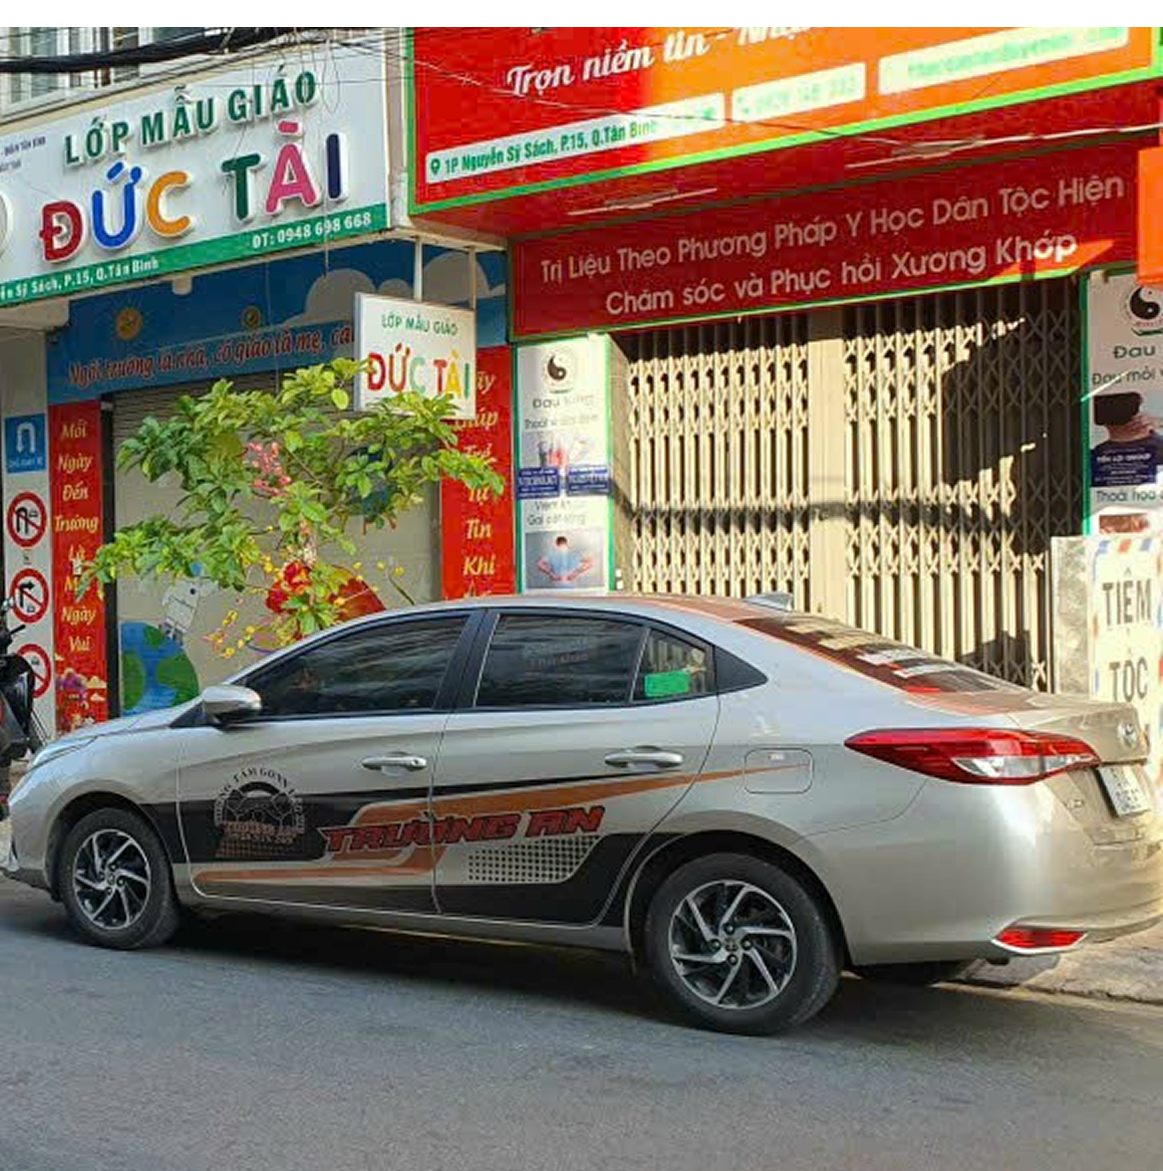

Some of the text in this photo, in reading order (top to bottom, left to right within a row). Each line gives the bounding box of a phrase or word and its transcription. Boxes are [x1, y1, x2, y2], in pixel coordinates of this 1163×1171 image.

[506, 61, 575, 96] Trọn
[663, 30, 713, 63] tin
[64, 63, 318, 166] LỚP MẪU GIÁO
[461, 147, 504, 172] Nguyễn
[591, 125, 626, 146] Q.Tân
[39, 120, 350, 263] ĐỨC TÀI
[277, 224, 312, 243] 0948
[315, 217, 342, 236] 698
[344, 211, 372, 229] 668
[540, 174, 1126, 285] Trị Liệu Theo Phương Pháp Y Học Dân Tộc Hiện
[605, 229, 1078, 316] Chăm sóc và Phục hồi Xương Khớp
[381, 313, 403, 329] LỚP
[235, 332, 272, 365] giáo
[274, 328, 292, 356] là
[1112, 345, 1157, 360] Đau
[367, 341, 426, 394] ĐỨC
[433, 349, 470, 399] TÀI
[62, 418, 89, 440] Mỗi
[57, 454, 94, 477] Ngày
[61, 482, 89, 502] Đến
[465, 519, 492, 540] Tin
[463, 554, 497, 576] Khi
[60, 605, 97, 626] Ngày
[68, 634, 92, 653] Vui
[321, 807, 520, 853] TRƯỜNG
[523, 804, 606, 836] AN
